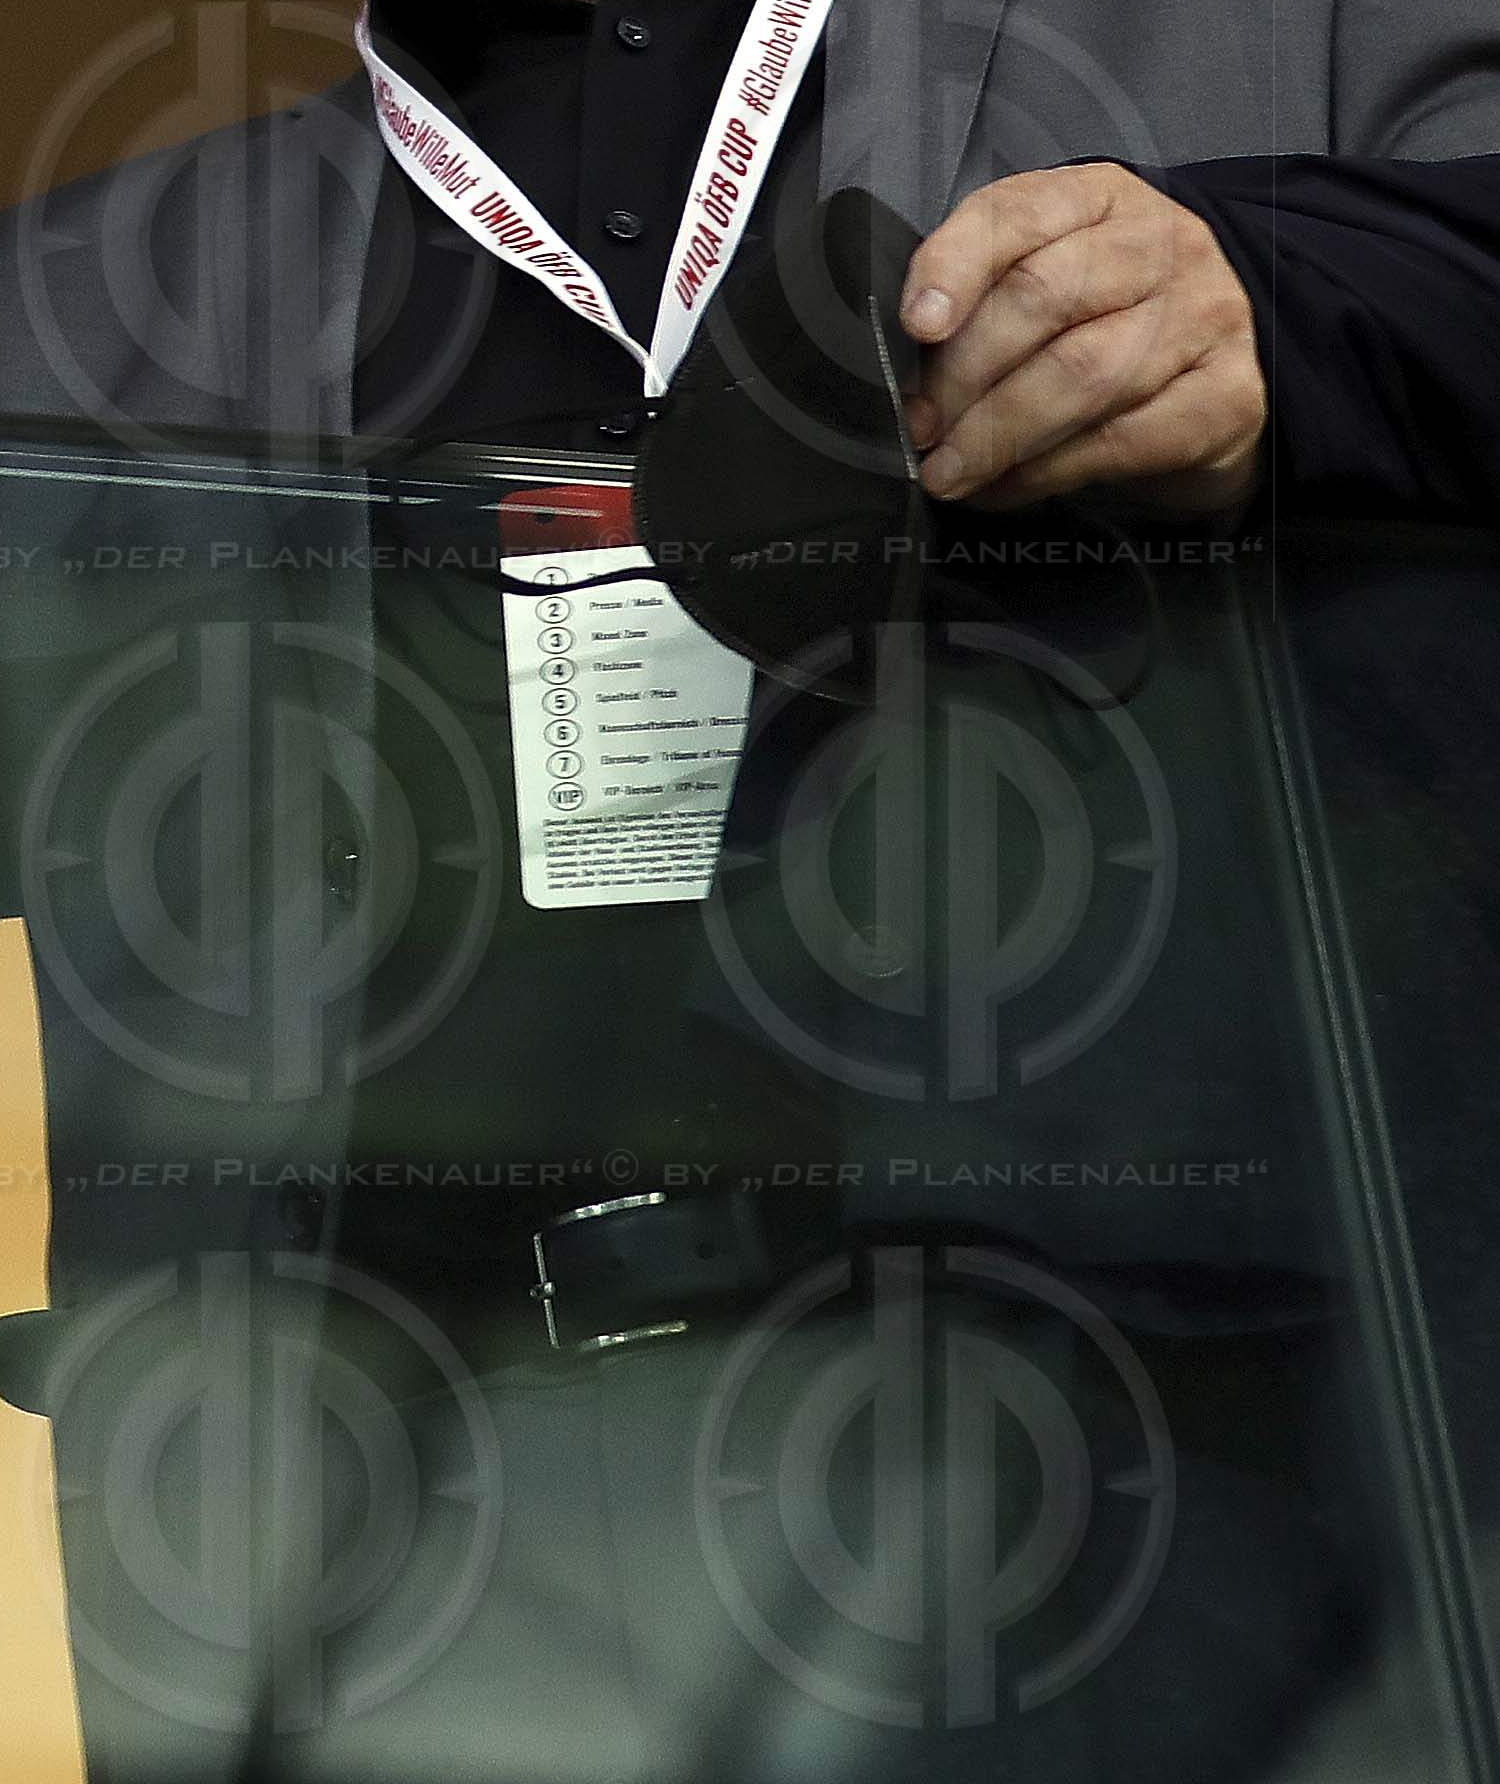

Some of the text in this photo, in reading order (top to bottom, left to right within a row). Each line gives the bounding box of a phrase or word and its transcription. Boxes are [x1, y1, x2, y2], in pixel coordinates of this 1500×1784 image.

[716, 117, 759, 177] CUP
[468, 191, 546, 254] UNIQA
[693, 171, 740, 229] ÖFB
[674, 221, 724, 311] UNIQA
